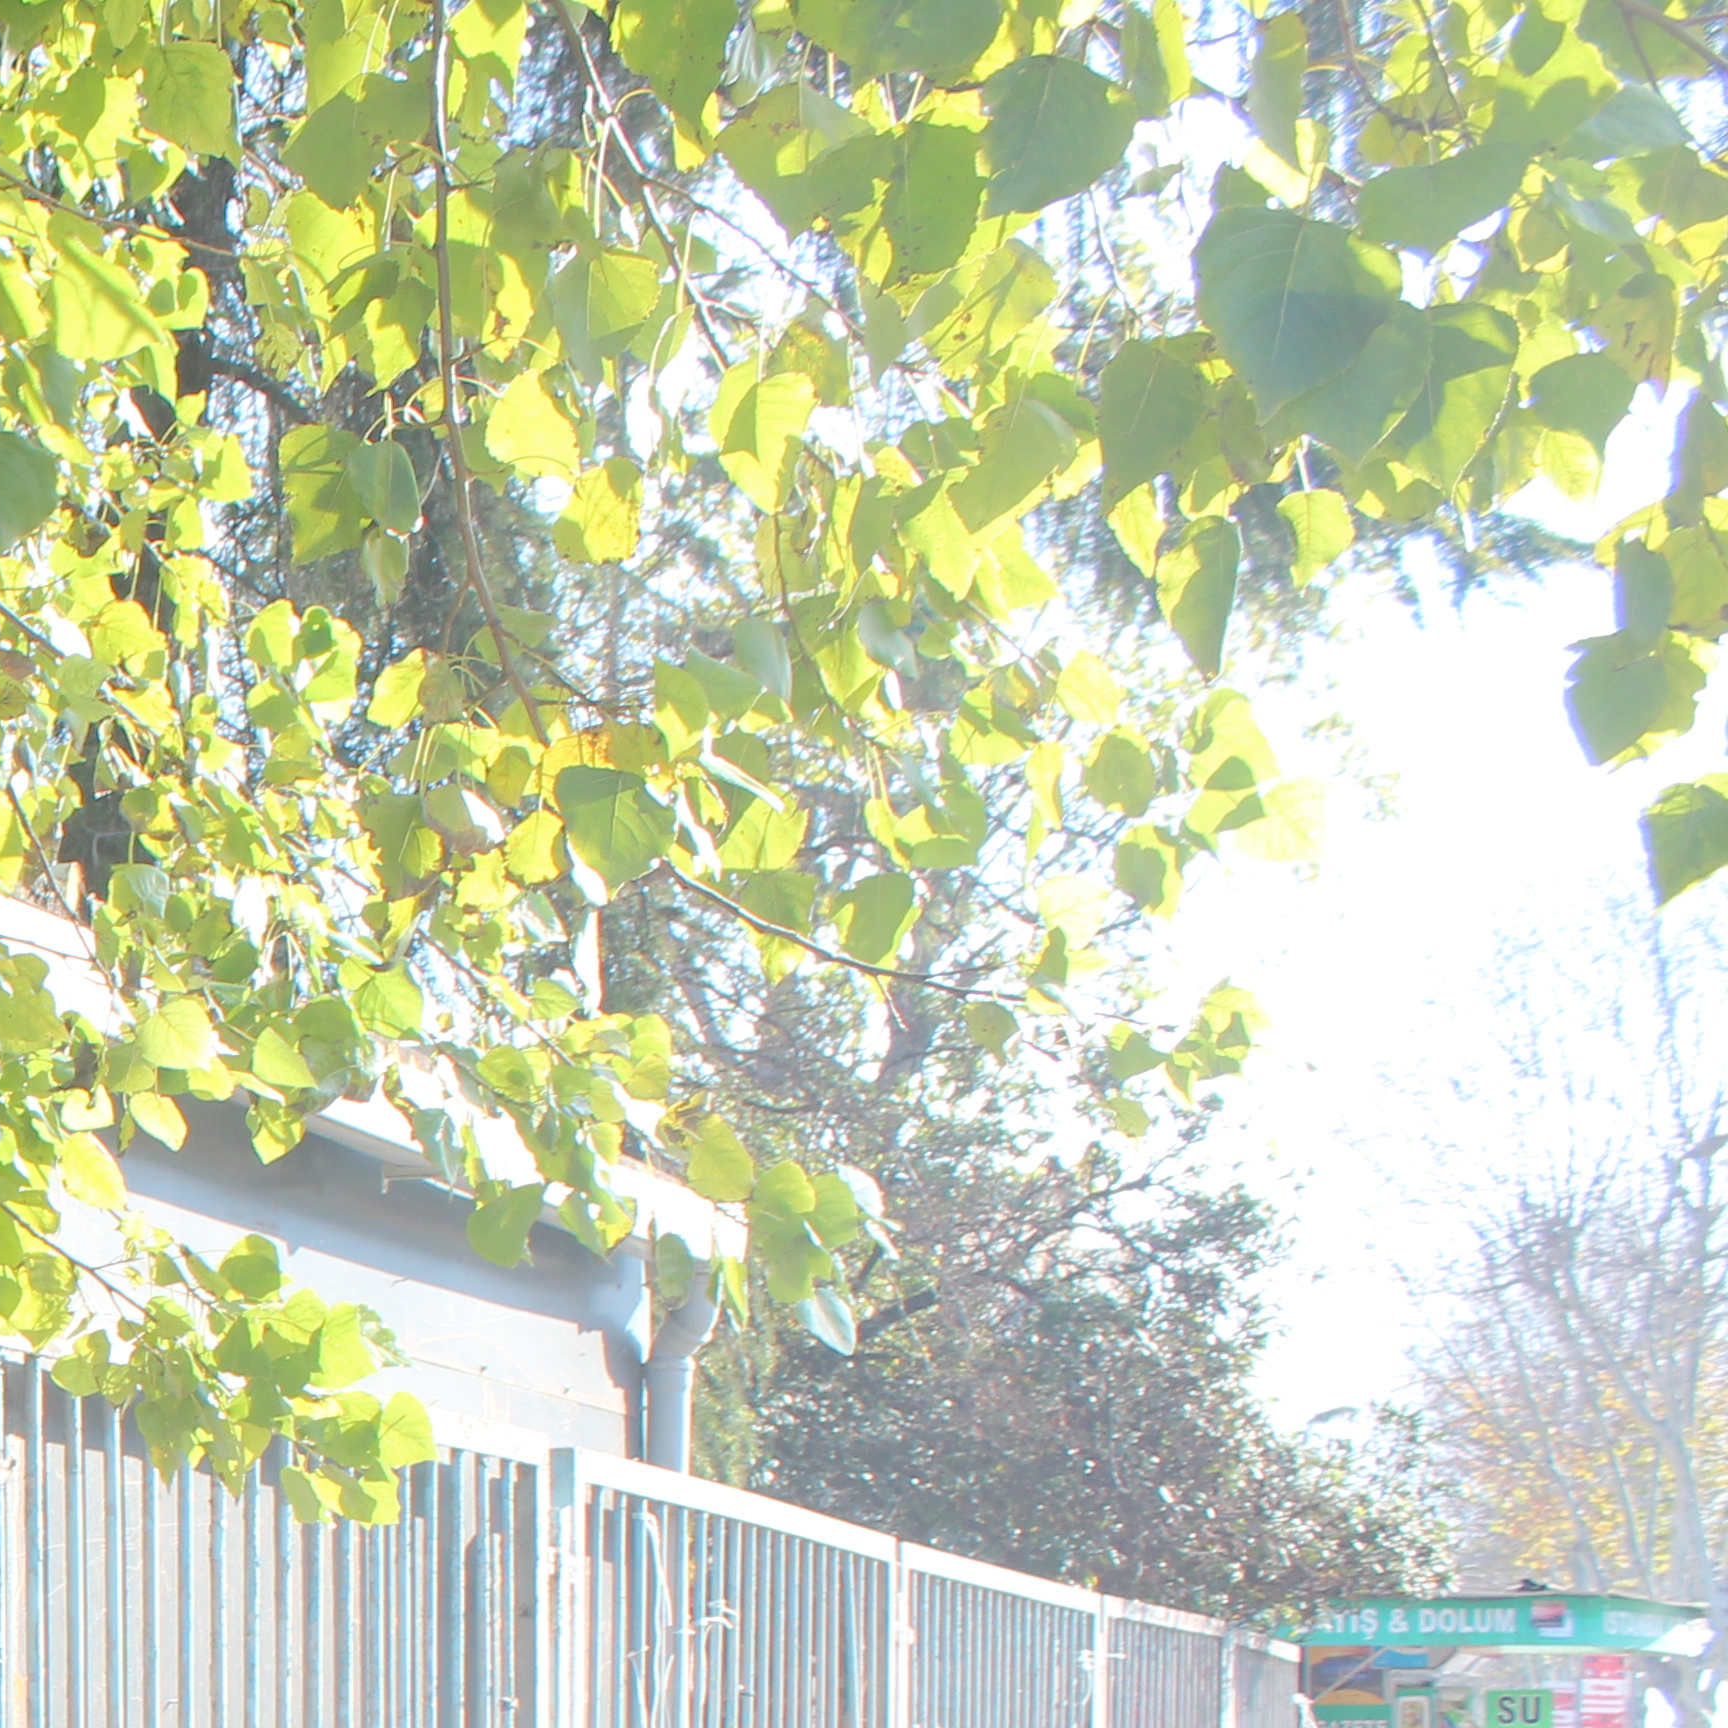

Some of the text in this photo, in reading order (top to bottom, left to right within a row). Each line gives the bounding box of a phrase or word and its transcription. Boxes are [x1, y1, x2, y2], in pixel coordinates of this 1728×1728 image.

[1388, 1608, 1410, 1633] &
[1418, 1607, 1517, 1634] DOLUM
[1496, 1696, 1541, 1725] SU
